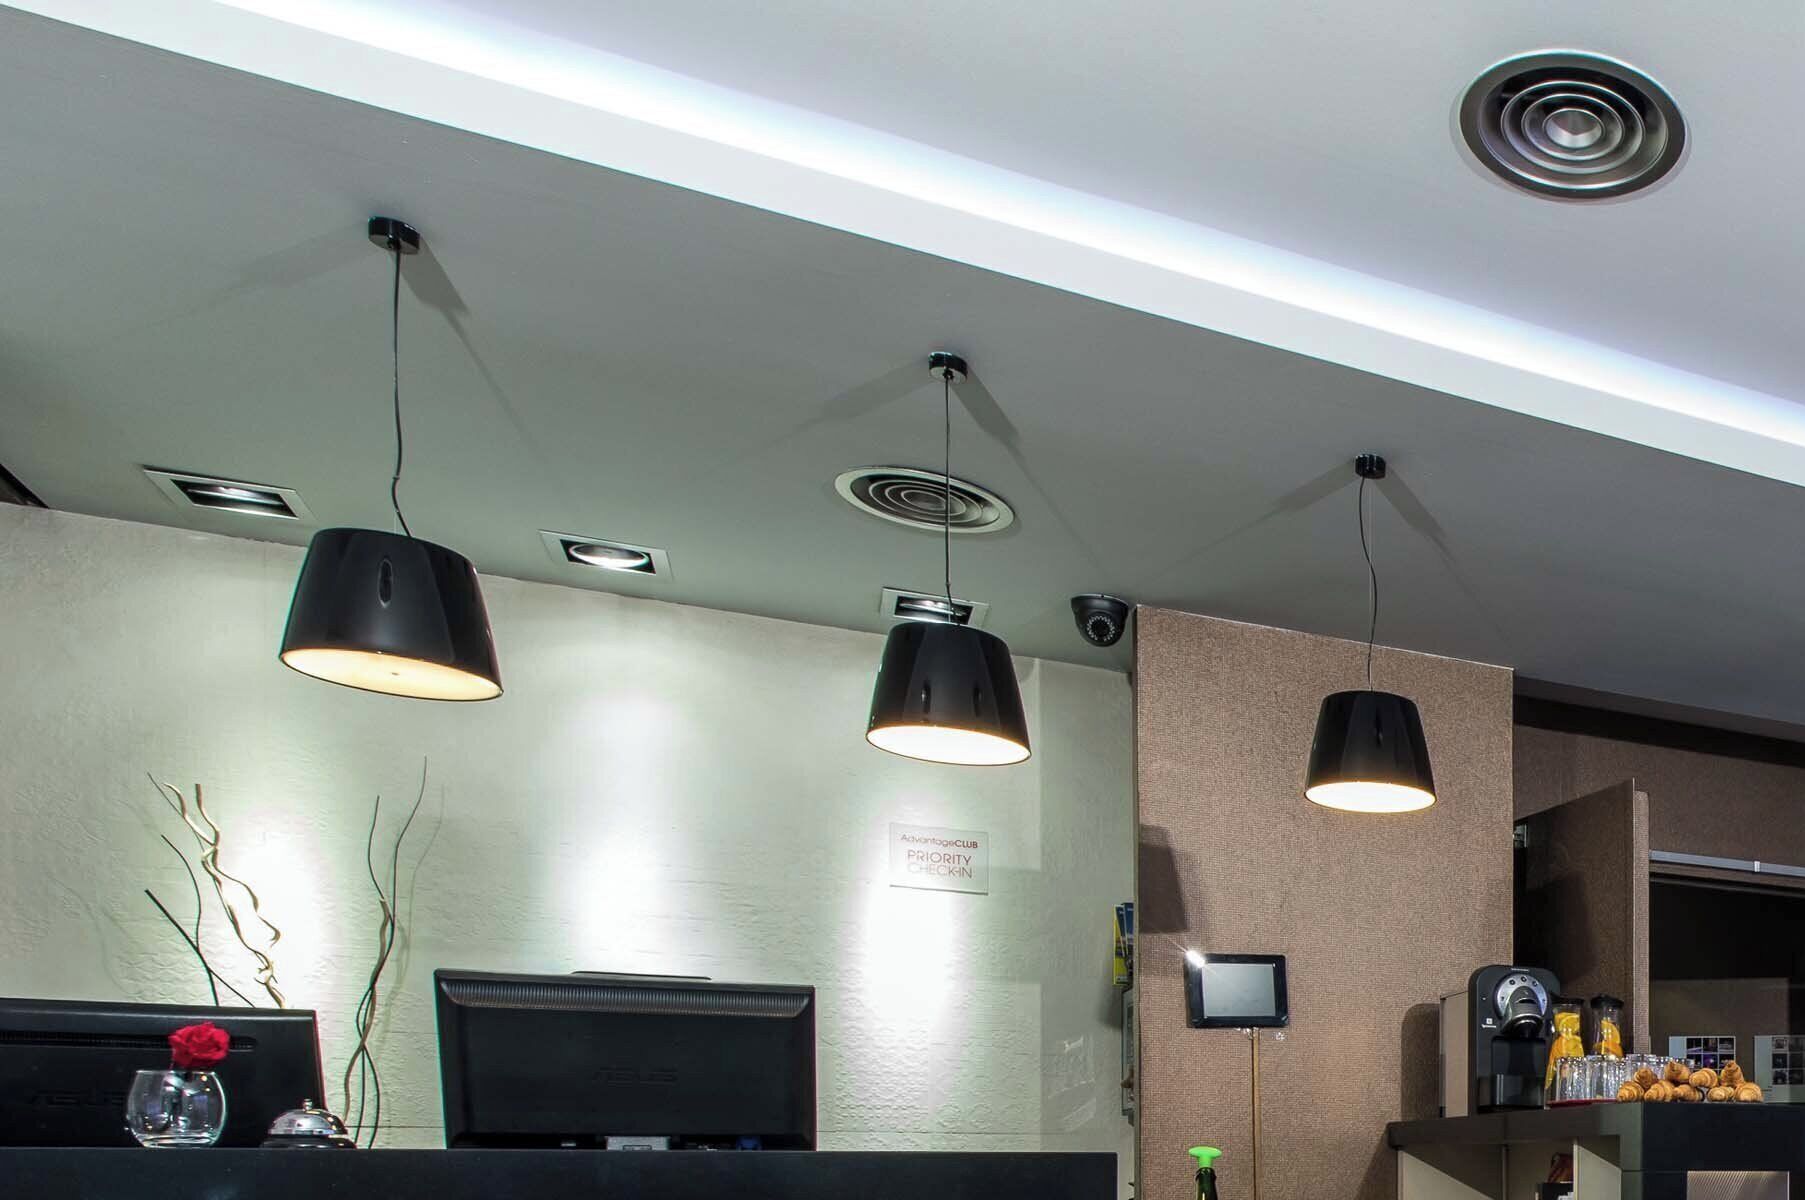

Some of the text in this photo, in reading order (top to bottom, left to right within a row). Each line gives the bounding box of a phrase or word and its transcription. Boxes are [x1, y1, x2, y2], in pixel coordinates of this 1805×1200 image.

[907, 849, 972, 866] PRIORITY
[907, 863, 973, 879] CHECK-IN
[592, 1067, 678, 1087] ASUS
